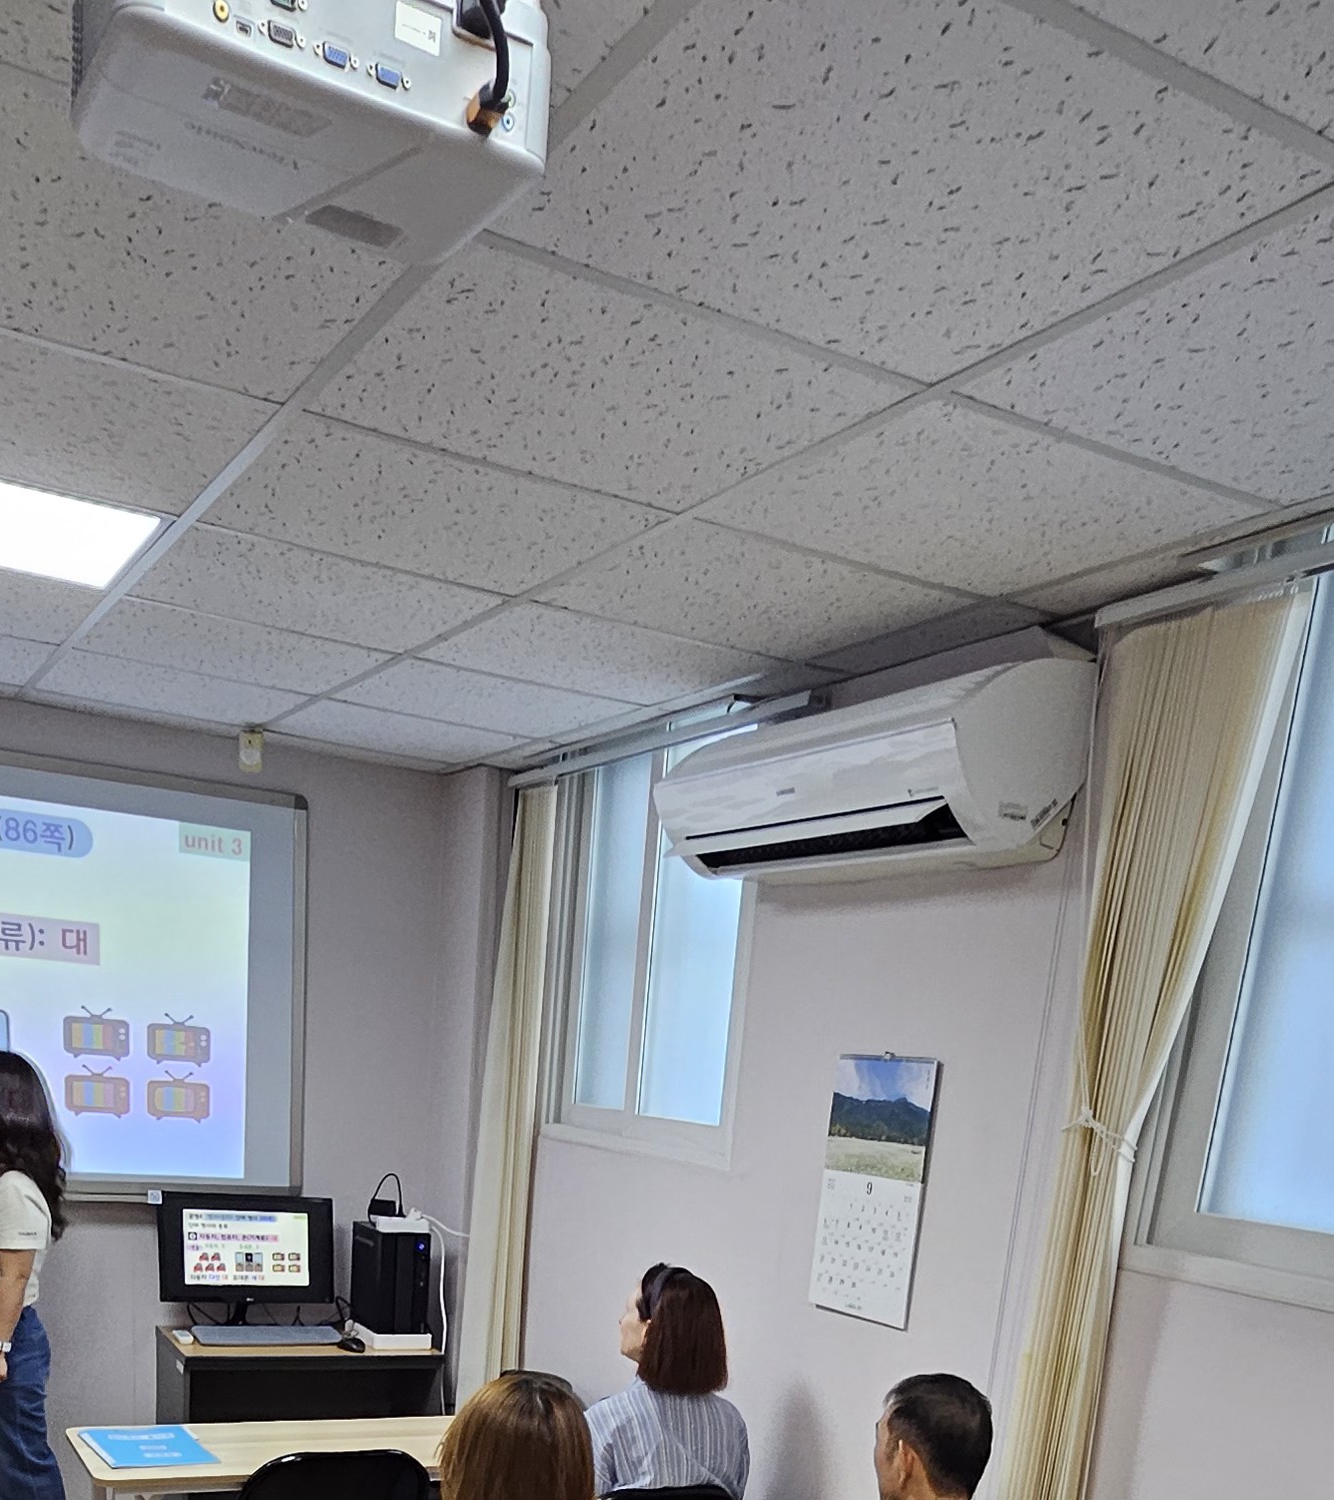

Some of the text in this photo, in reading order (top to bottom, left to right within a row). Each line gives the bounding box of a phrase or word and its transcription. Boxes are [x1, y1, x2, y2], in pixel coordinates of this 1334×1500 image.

[183, 833, 243, 856] unit 3
[61, 927, 89, 957] 대
[866, 1181, 873, 1196] 9
